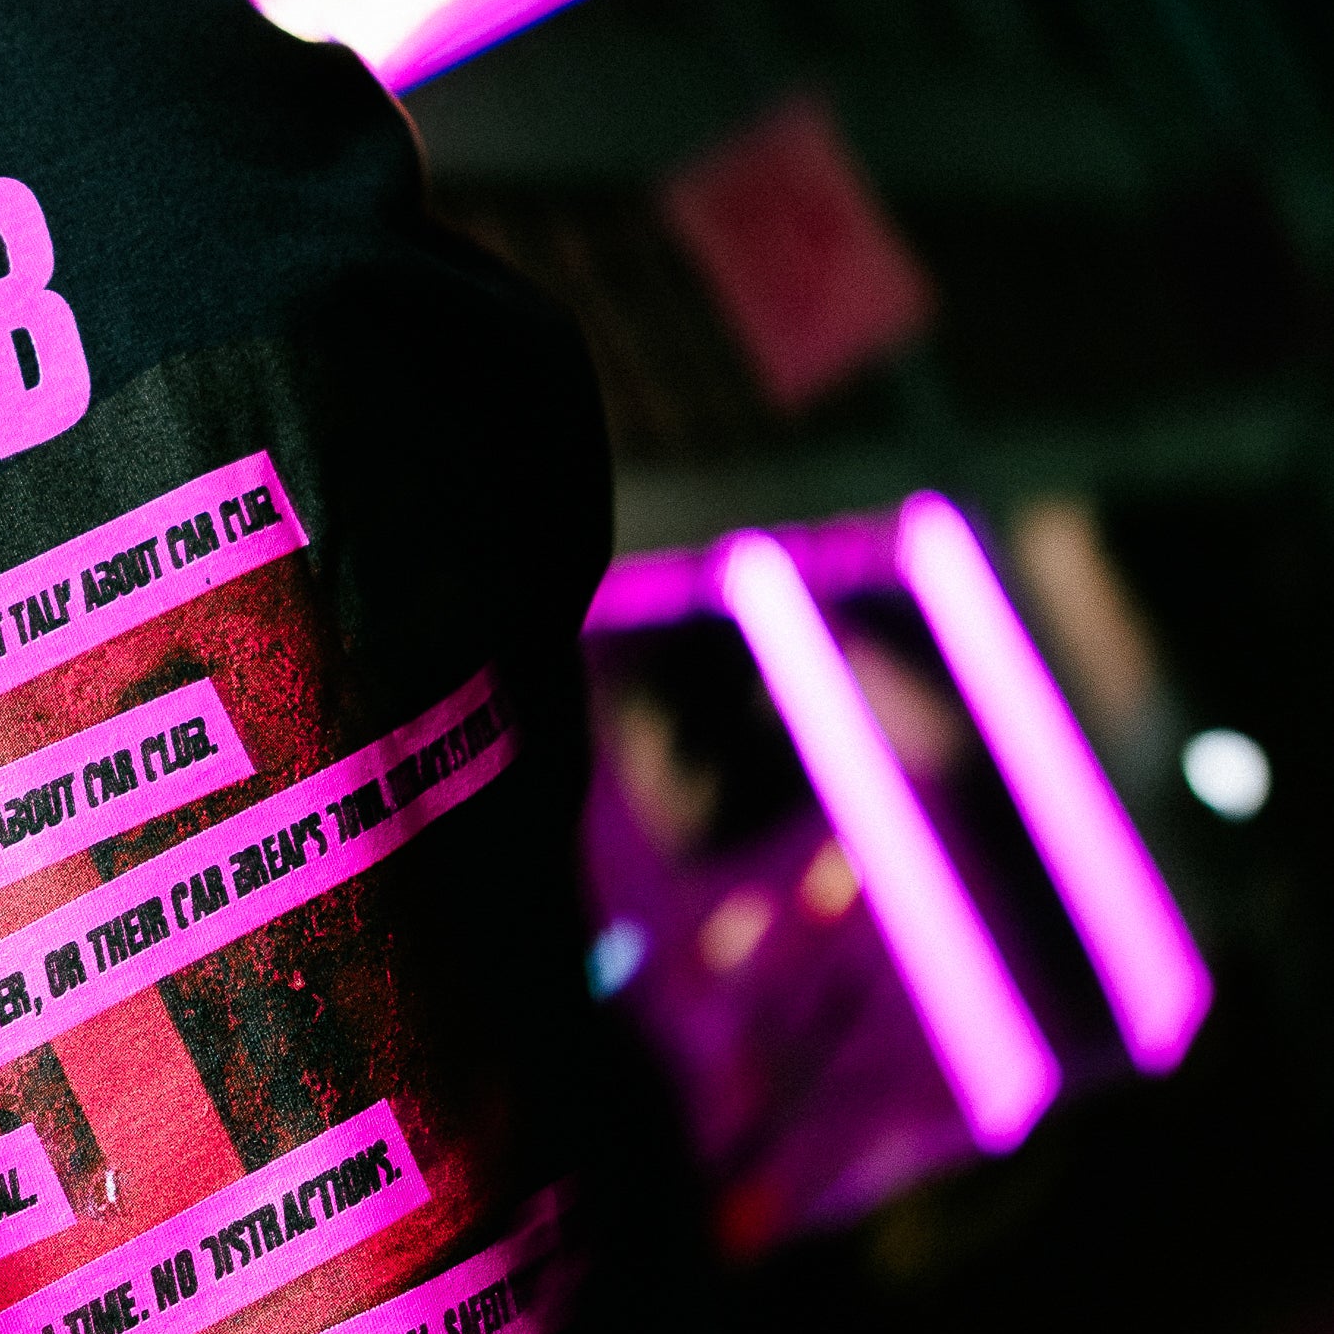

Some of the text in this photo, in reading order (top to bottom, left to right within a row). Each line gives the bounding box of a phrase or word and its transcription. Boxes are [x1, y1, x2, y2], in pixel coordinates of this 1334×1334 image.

[80, 536, 164, 614] ABOUT
[168, 512, 219, 569] CAR
[84, 749, 139, 809] CAR
[44, 942, 86, 1000] OR
[86, 896, 172, 974] THEIR
[170, 865, 231, 930] CAR
[150, 1249, 198, 1314] NO
